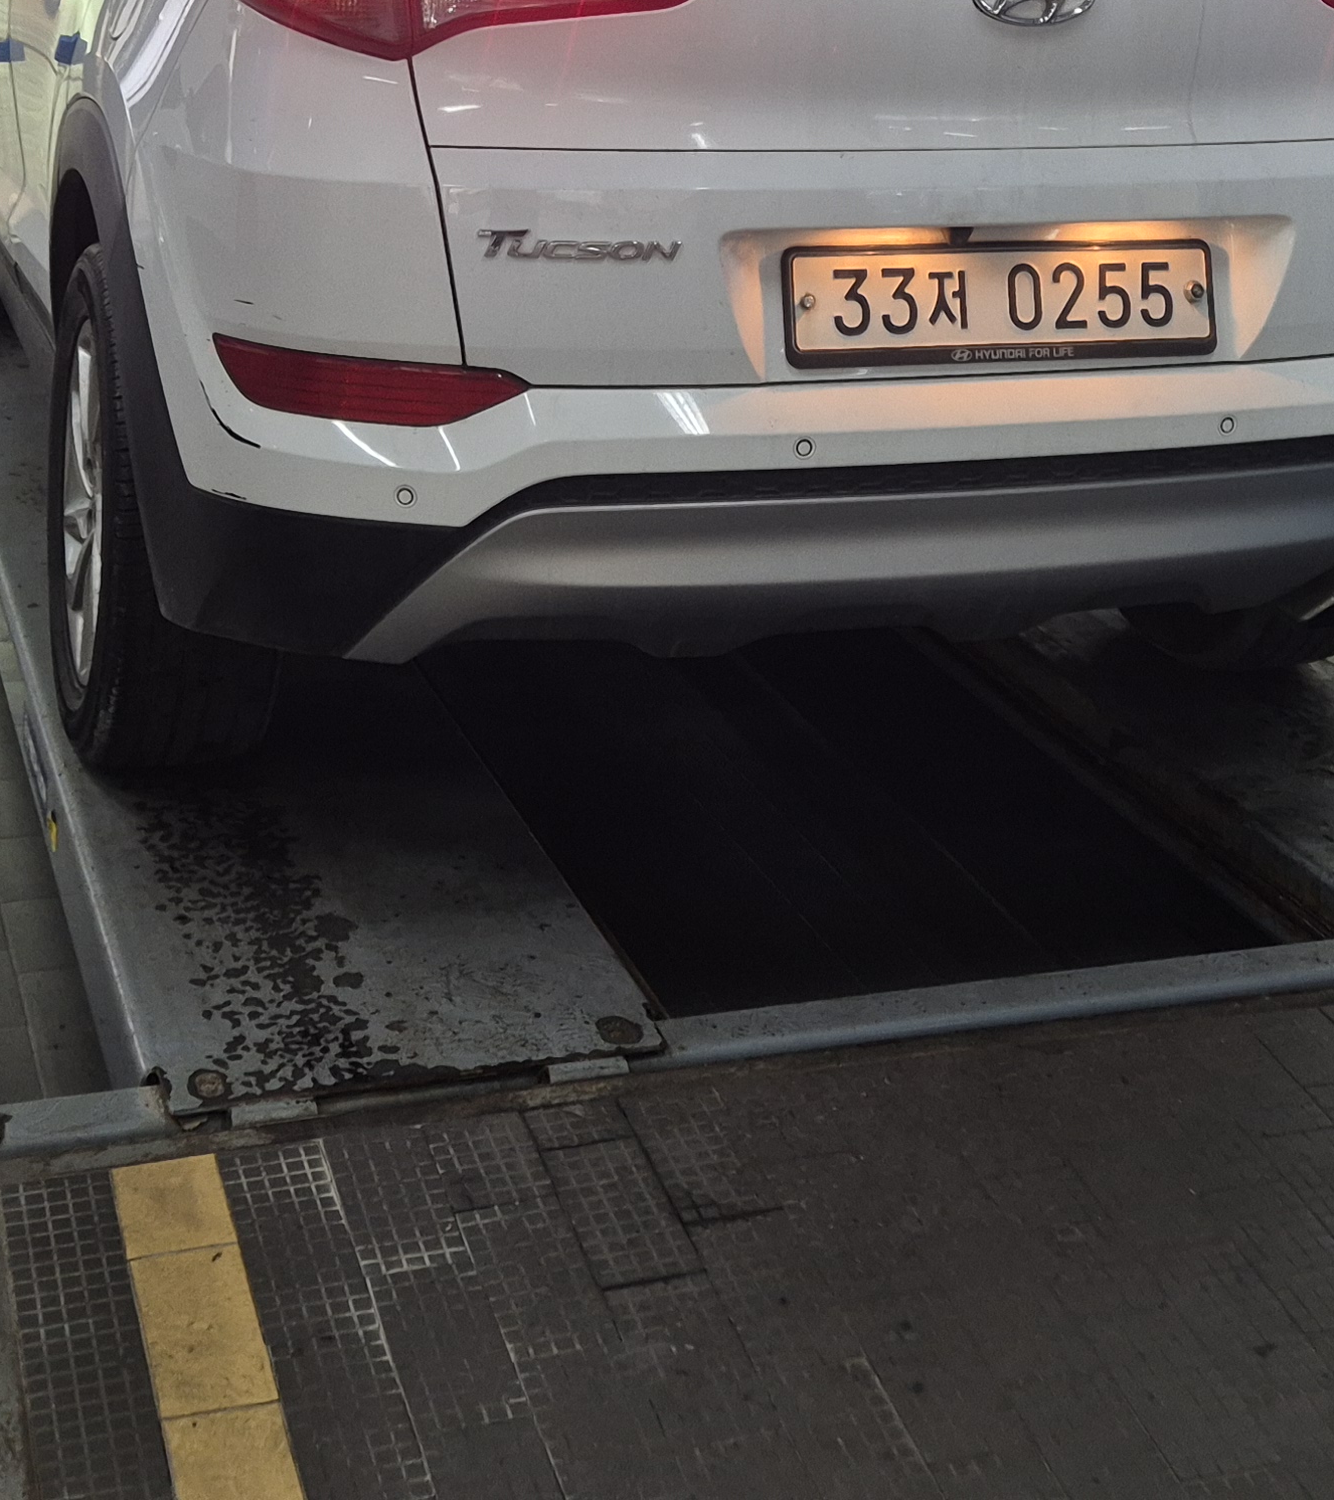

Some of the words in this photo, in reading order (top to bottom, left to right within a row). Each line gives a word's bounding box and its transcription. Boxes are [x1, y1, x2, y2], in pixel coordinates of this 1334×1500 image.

[832, 266, 969, 337] 33저
[1007, 261, 1174, 331] 0255
[975, 348, 1027, 360] HYUNDAI
[1028, 347, 1050, 359] FOR
[1052, 346, 1075, 358] LIFE
